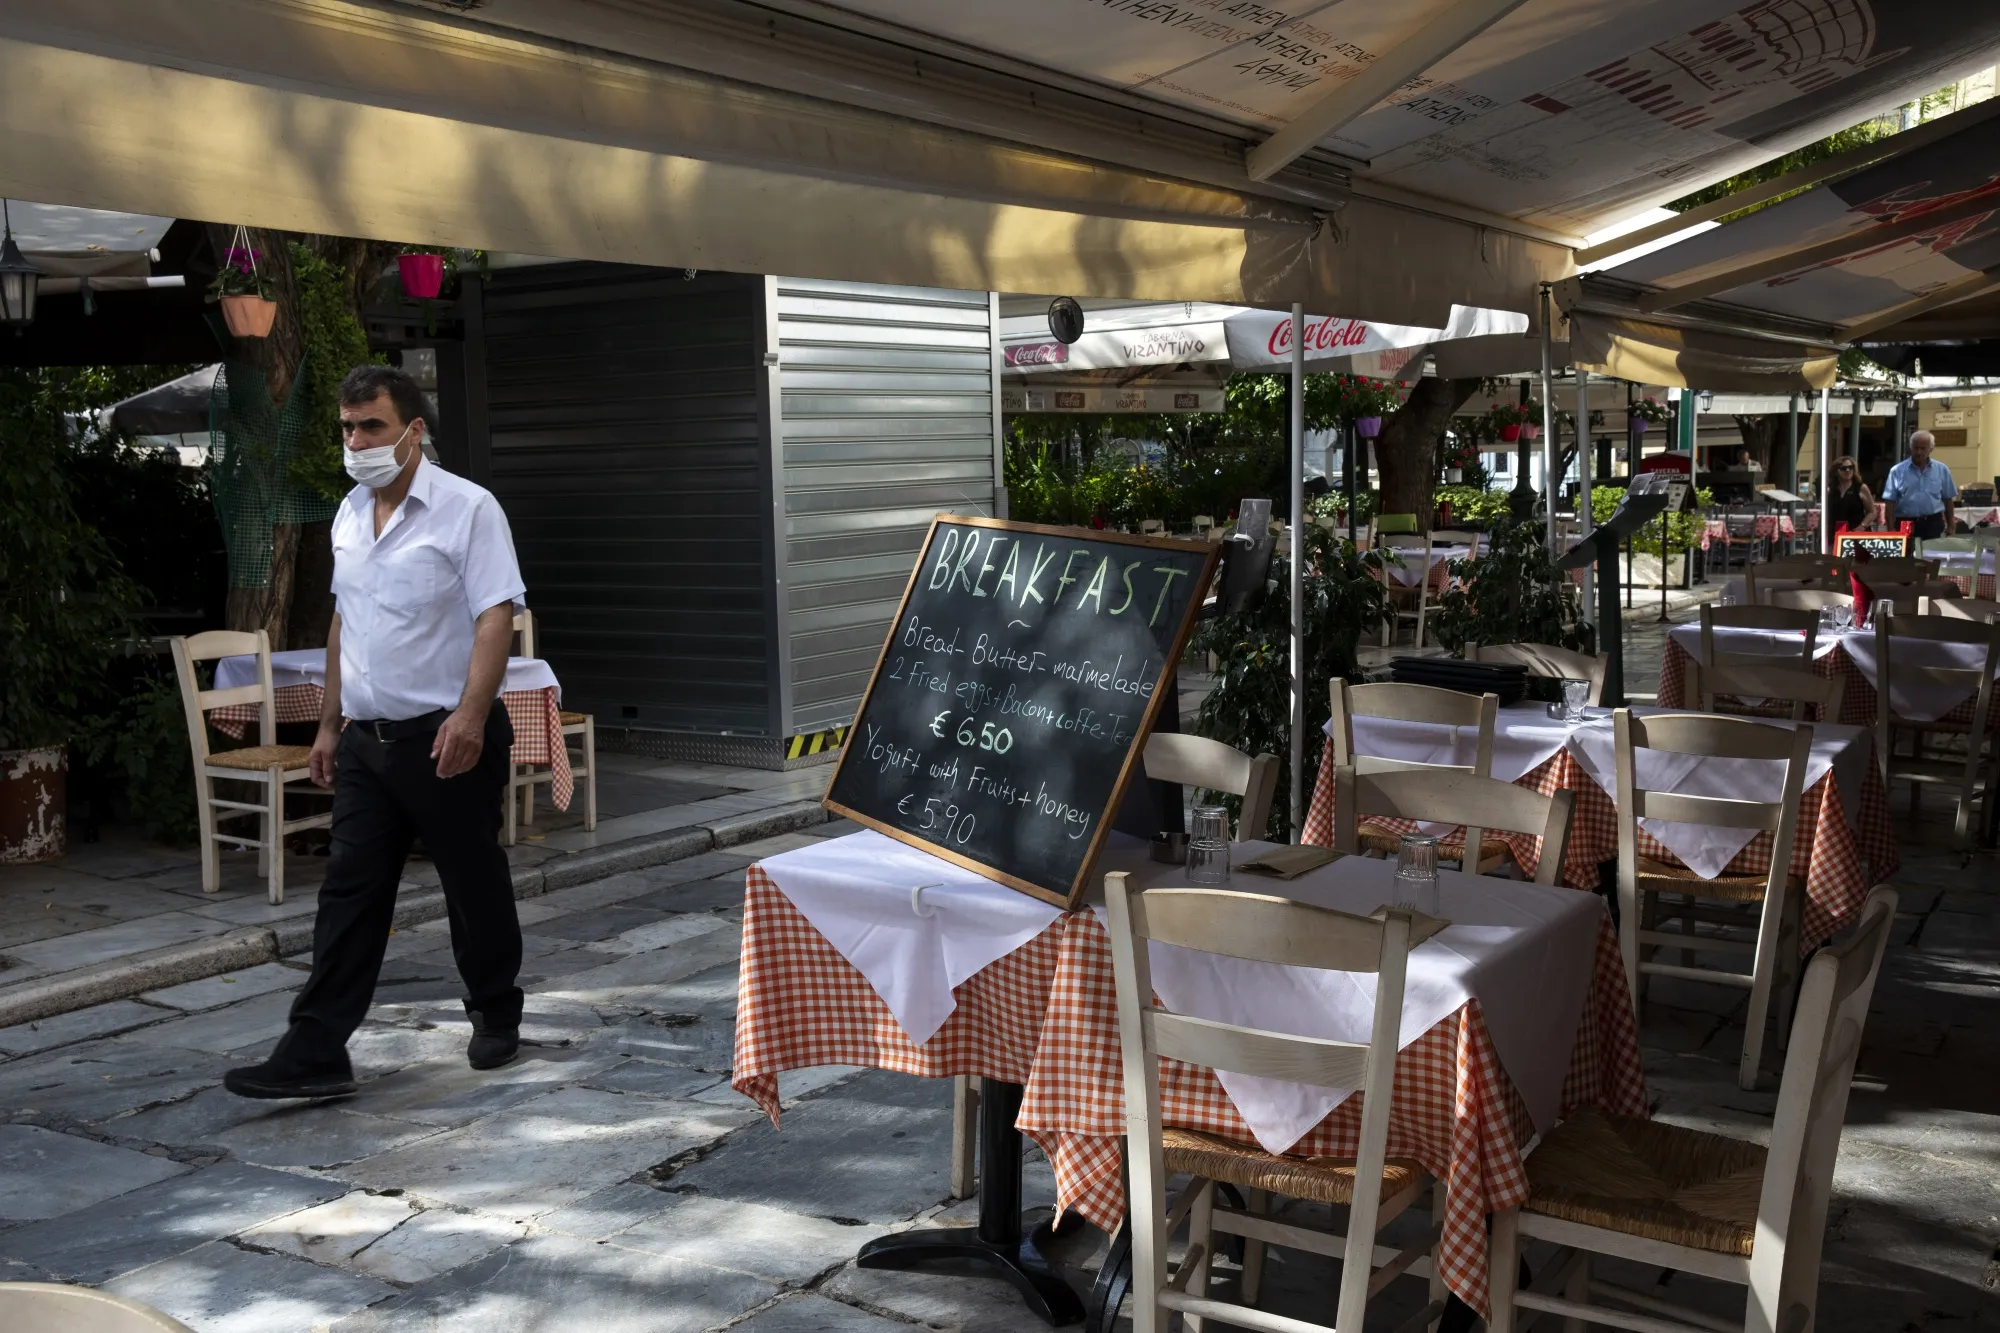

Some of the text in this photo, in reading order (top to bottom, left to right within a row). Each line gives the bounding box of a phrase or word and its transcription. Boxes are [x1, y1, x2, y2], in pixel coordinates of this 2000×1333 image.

[1246, 31, 1328, 66] ATHENS
[1123, 340, 1205, 359] VIZANTINO
[1268, 316, 1368, 356] Coa-Cola
[1014, 344, 1059, 364] Coca-Cola
[929, 529, 1189, 628] BREAKFAST
[889, 657, 905, 679] 2
[1054, 654, 1154, 698] marmelade
[929, 757, 959, 790] with
